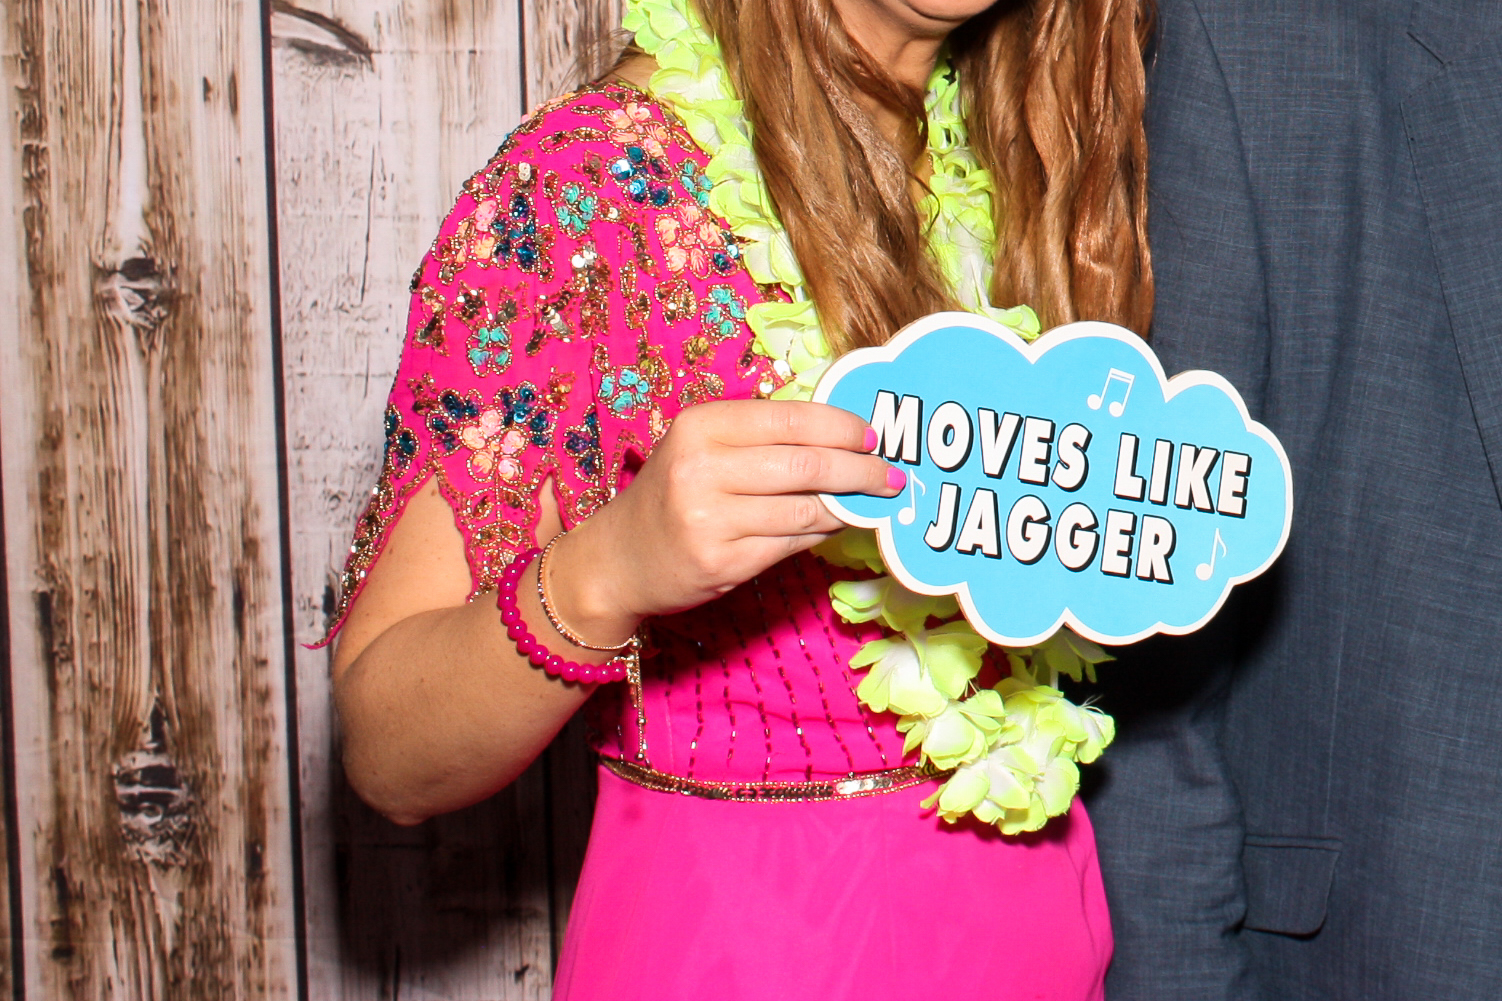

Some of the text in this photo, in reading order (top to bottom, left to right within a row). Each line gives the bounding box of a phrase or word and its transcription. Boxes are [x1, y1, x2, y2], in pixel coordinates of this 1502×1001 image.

[870, 389, 1252, 518] MOVES LIKE
[923, 482, 1177, 584] JAGGER
